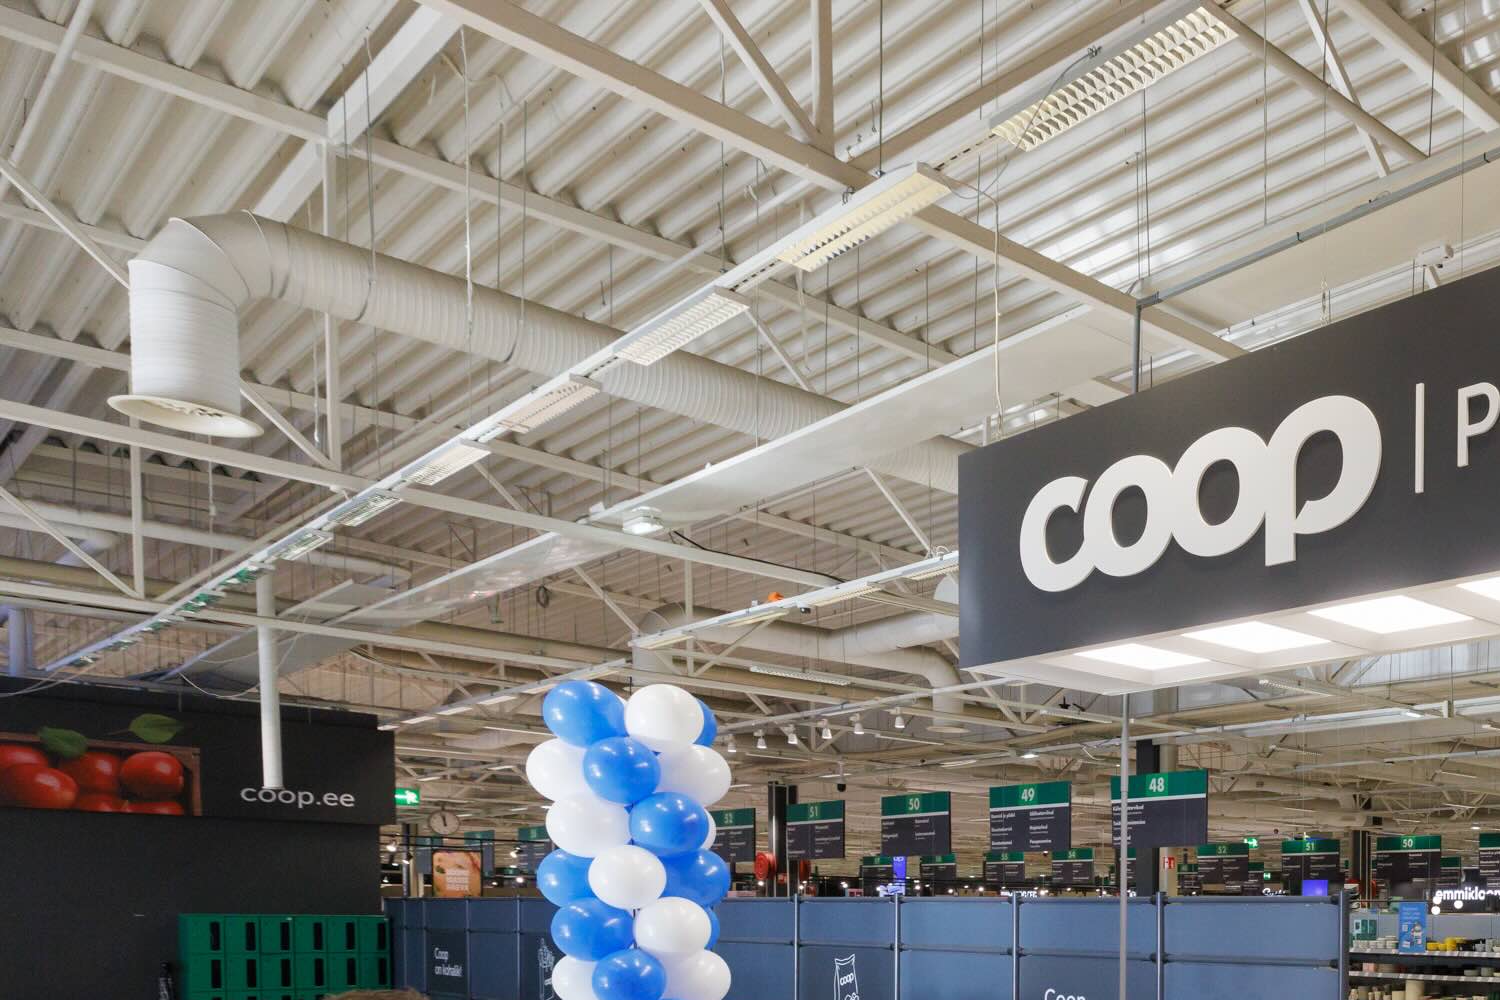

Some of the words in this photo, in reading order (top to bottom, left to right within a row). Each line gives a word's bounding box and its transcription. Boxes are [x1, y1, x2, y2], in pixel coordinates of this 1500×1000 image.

[1018, 394, 1383, 593] coop
[1149, 777, 1165, 793] 48
[240, 787, 356, 808] coop.ee
[1021, 787, 1035, 802] 49
[908, 798, 920, 811] 50
[1402, 838, 1414, 848] 50
[434, 947, 449, 961] Coop
[840, 973, 855, 986] coop
